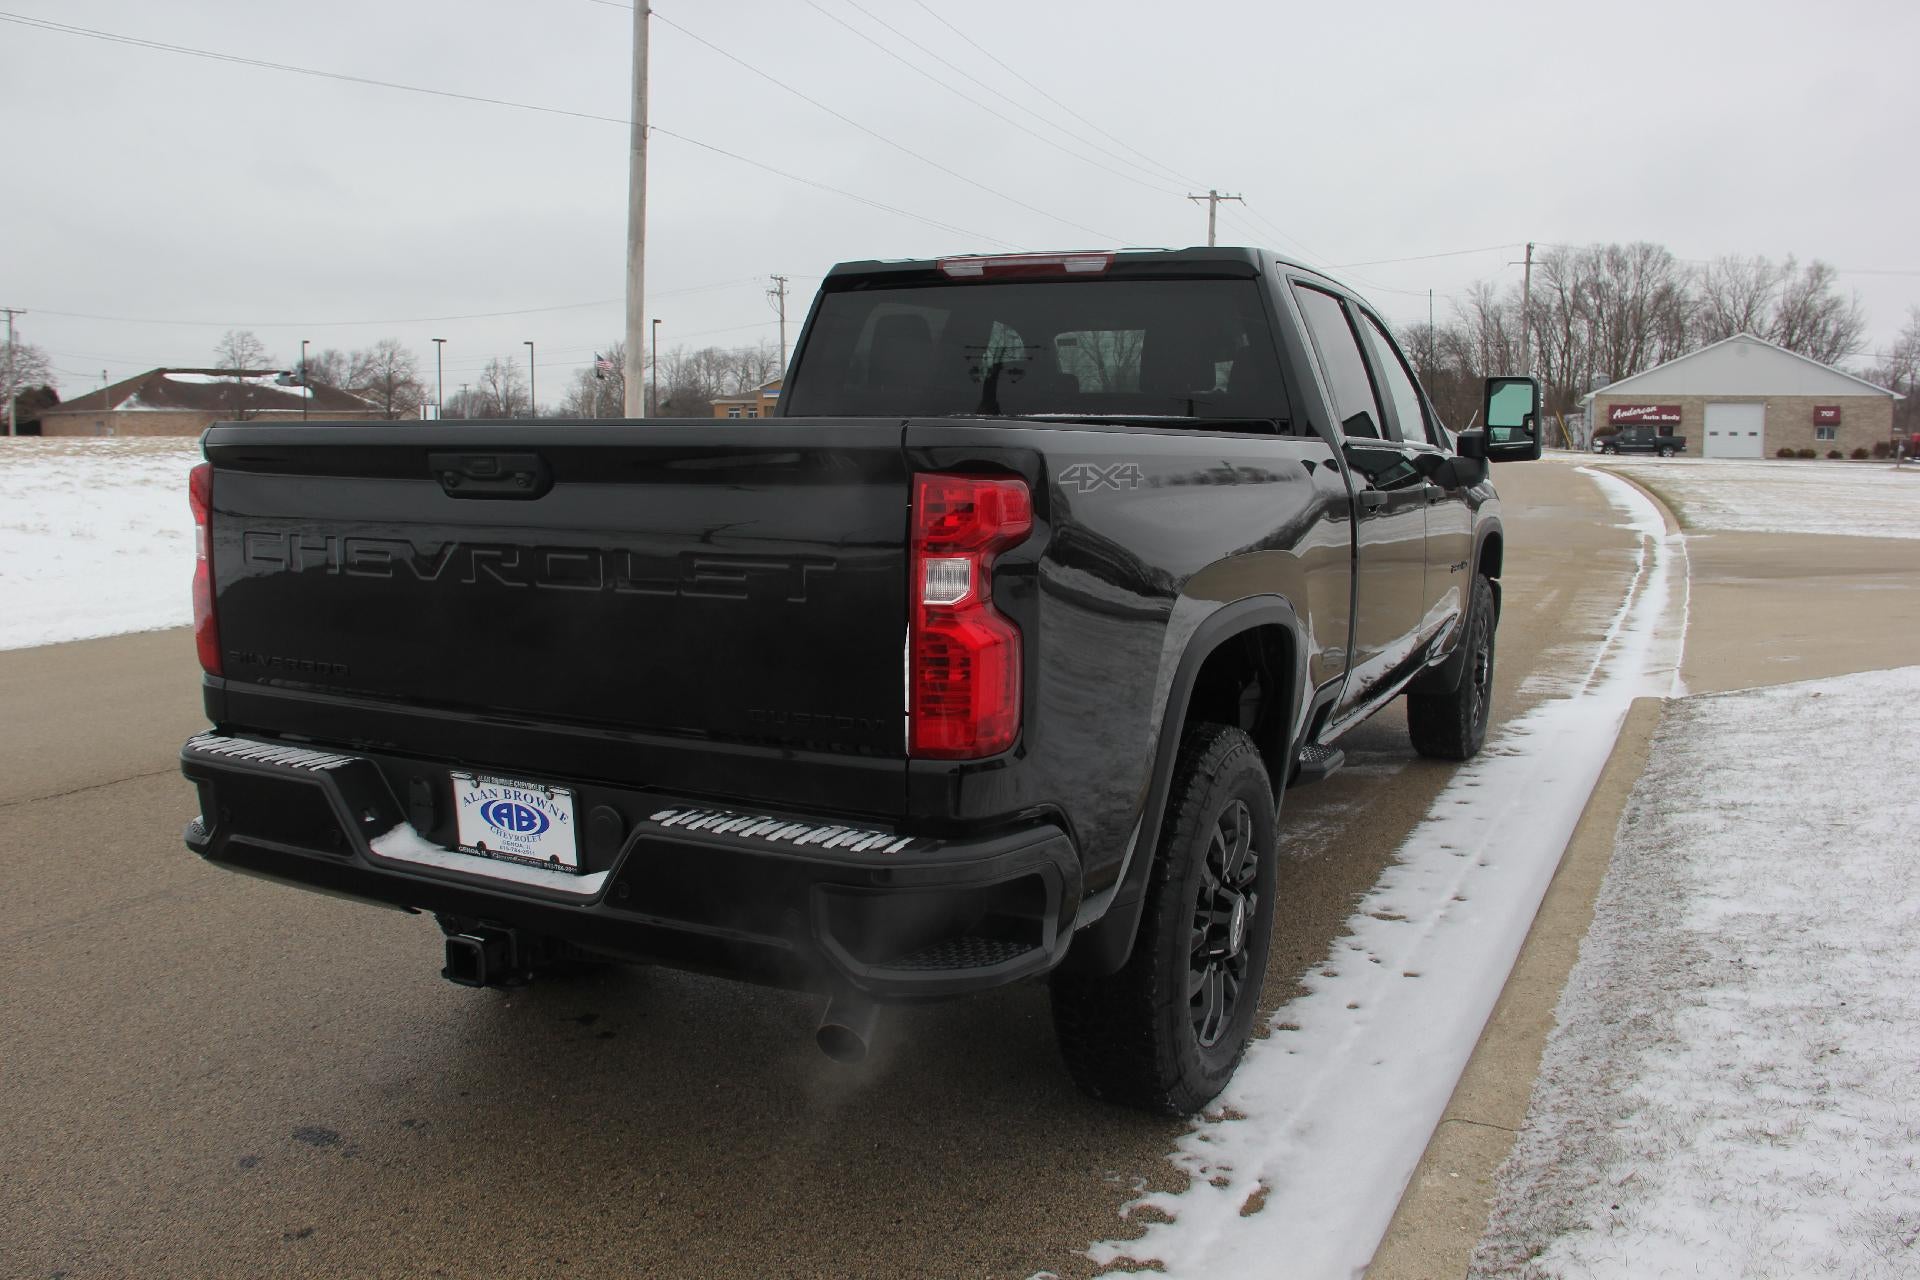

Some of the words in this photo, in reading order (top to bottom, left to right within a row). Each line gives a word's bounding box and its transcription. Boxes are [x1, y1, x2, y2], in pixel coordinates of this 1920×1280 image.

[242, 529, 838, 603] CHEVROLET
[228, 648, 352, 678] SILVERADO
[745, 706, 887, 733] CUSTOM
[514, 780, 545, 792] CHEVROLET
[463, 788, 498, 807] ALAN
[503, 788, 569, 825] BROWNE
[489, 826, 542, 843] CHEVROLET
